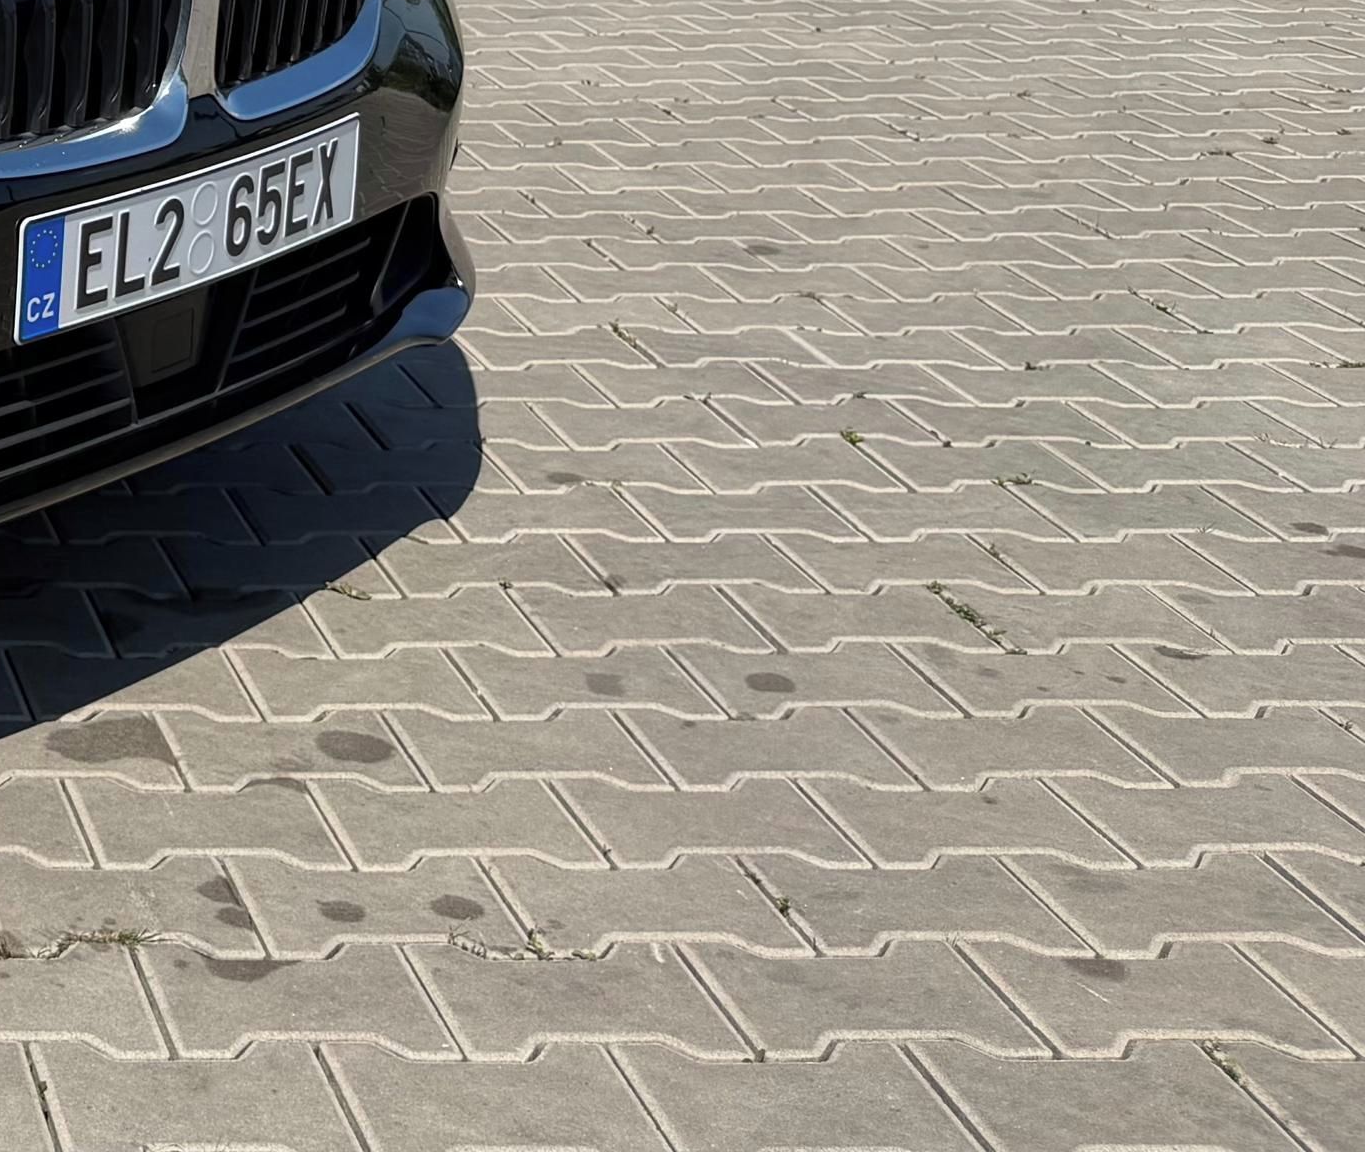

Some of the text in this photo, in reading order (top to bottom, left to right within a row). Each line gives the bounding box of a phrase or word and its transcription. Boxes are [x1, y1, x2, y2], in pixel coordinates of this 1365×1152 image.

[75, 137, 340, 310] EL2 65EX
[25, 291, 55, 324] CZ
